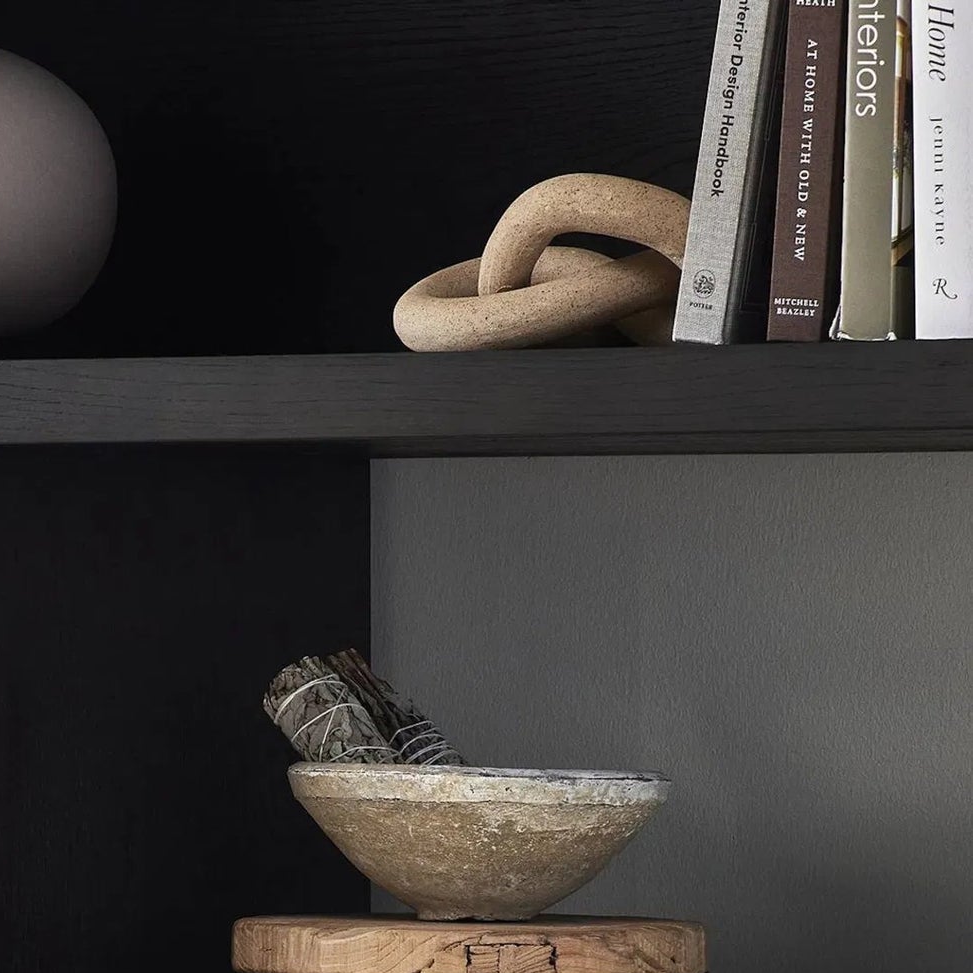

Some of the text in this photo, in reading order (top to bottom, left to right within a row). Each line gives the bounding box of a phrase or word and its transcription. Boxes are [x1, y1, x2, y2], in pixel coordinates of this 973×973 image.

[928, 4, 955, 82] Home
[722, 55, 743, 109] Design
[711, 115, 735, 198] Handbook
[794, 39, 818, 261] AT HOME WITH OLD & NEW
[774, 298, 819, 307] MITCHELL
[776, 308, 815, 316] BEAZLEY
